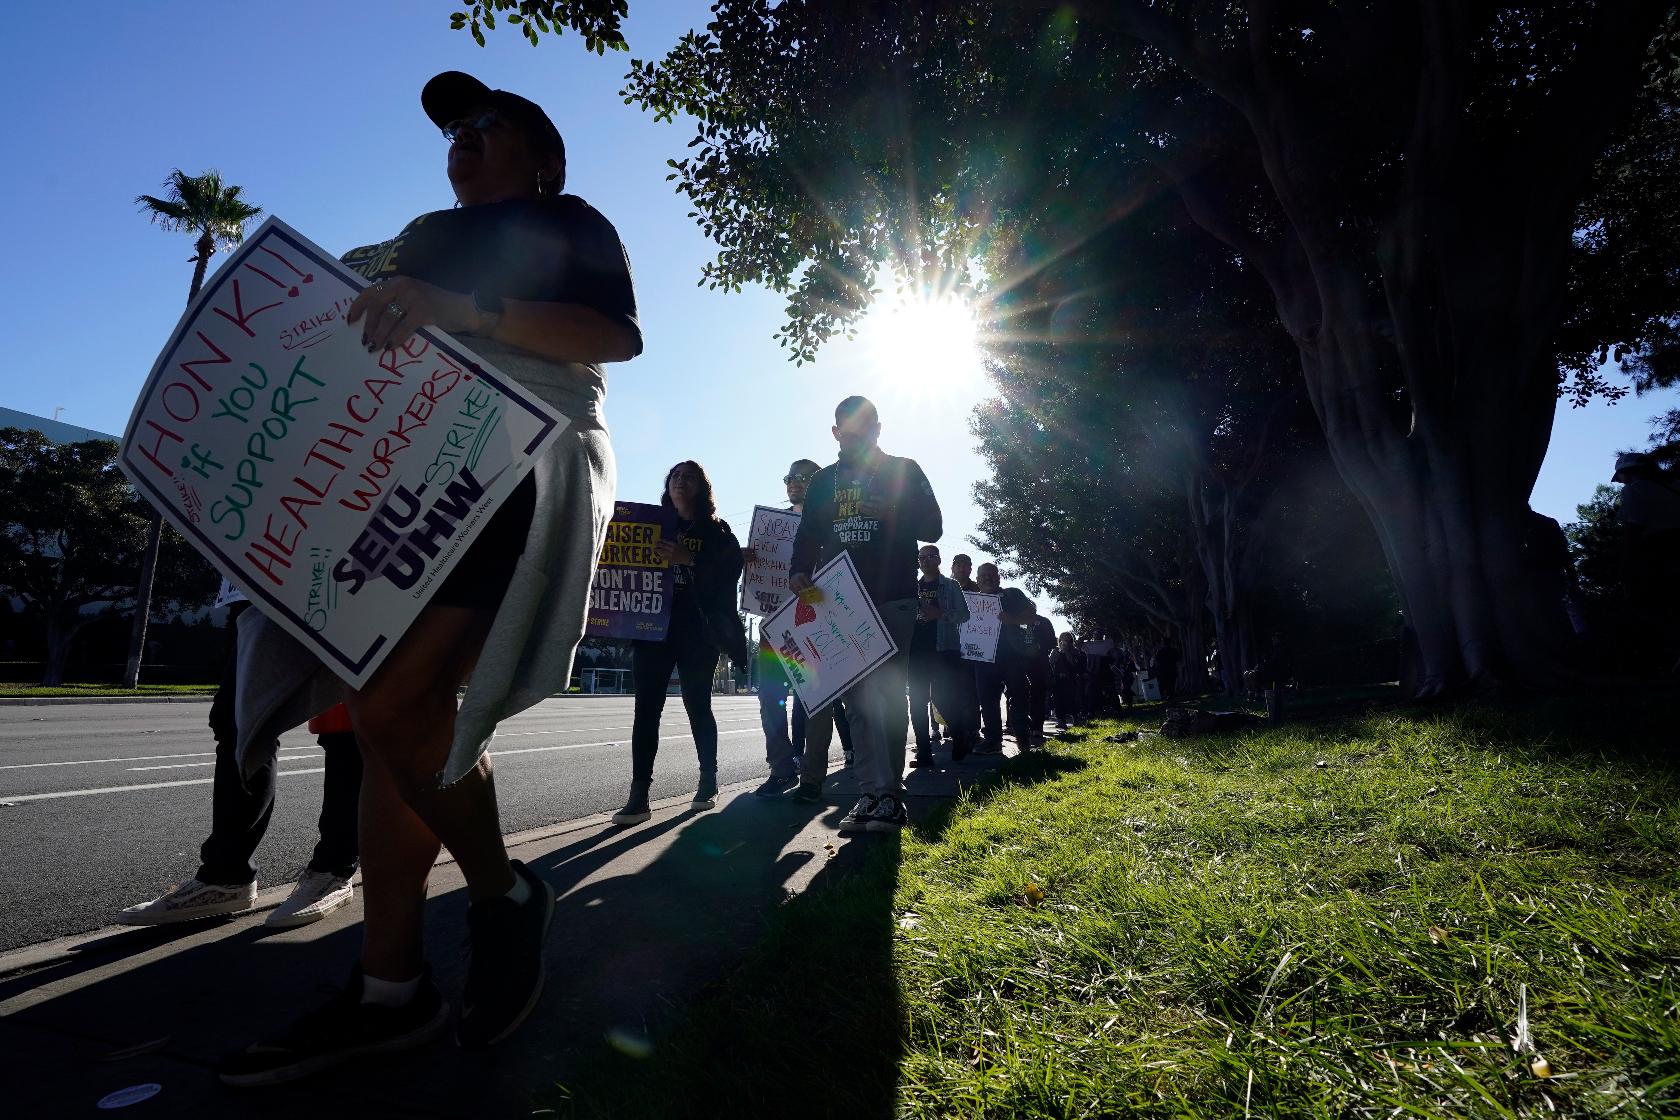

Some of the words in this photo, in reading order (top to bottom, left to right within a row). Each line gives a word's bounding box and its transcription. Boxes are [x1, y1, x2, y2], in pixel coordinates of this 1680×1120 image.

[212, 362, 268, 422] YOU
[211, 355, 326, 541] SUPPORT
[245, 336, 430, 586] HEALTHCARE
[333, 482, 427, 595] SEIU-
[381, 465, 485, 590] UHW
[606, 523, 654, 545] AISER
[833, 520, 879, 533] CORPORATE
[839, 530, 871, 543] GREED
[412, 575, 433, 599] United
[430, 543, 460, 576] Healthcare
[456, 511, 480, 541] Workers
[479, 497, 494, 513] West
[600, 544, 664, 564] ORKERS
[642, 570, 664, 592] BE
[771, 575, 790, 589] HER
